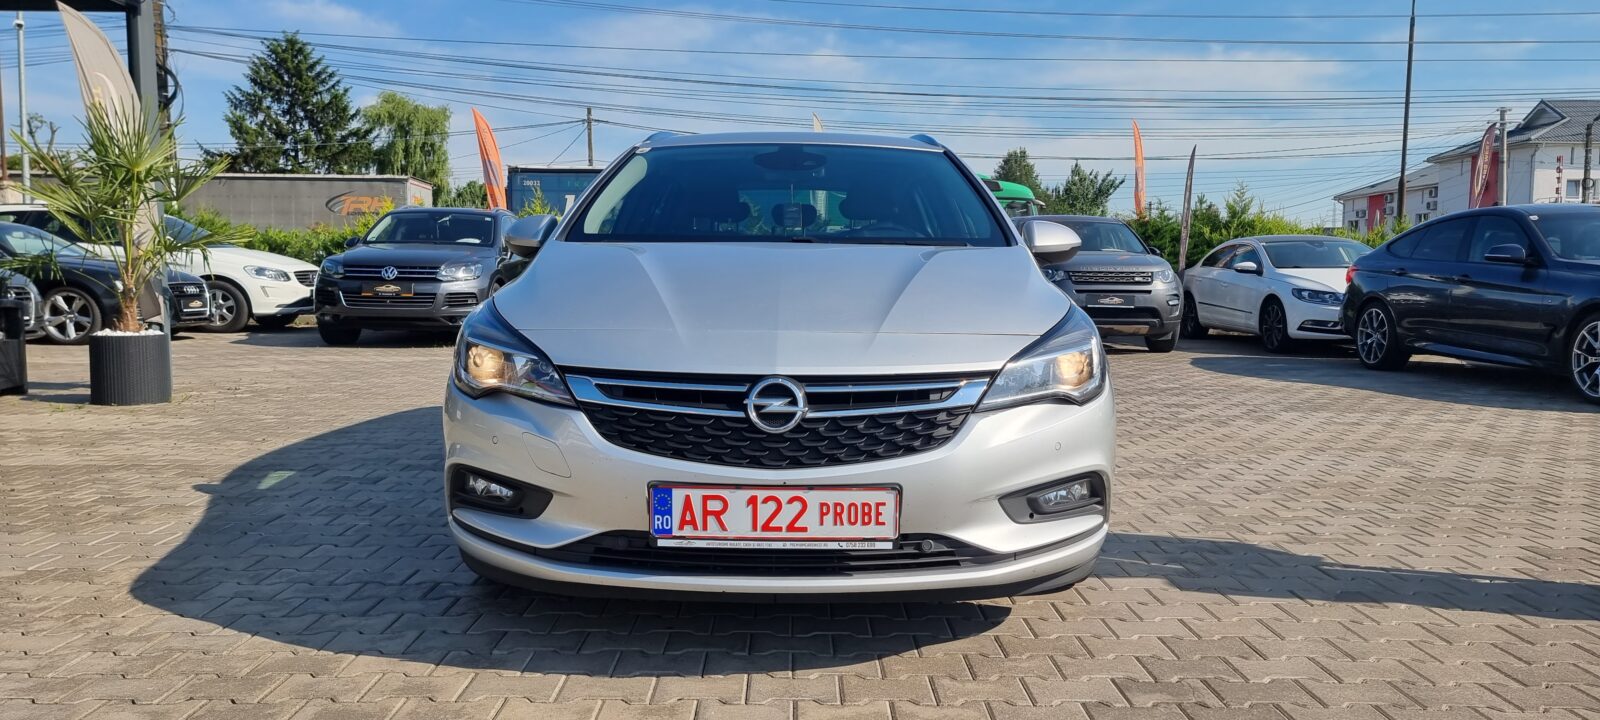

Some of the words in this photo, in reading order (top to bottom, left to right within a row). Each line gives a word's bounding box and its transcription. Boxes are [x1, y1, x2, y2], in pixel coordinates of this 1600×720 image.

[655, 515, 671, 530] RO
[678, 494, 729, 531] AR
[746, 494, 808, 532] 122
[819, 501, 886, 526] PROBE
